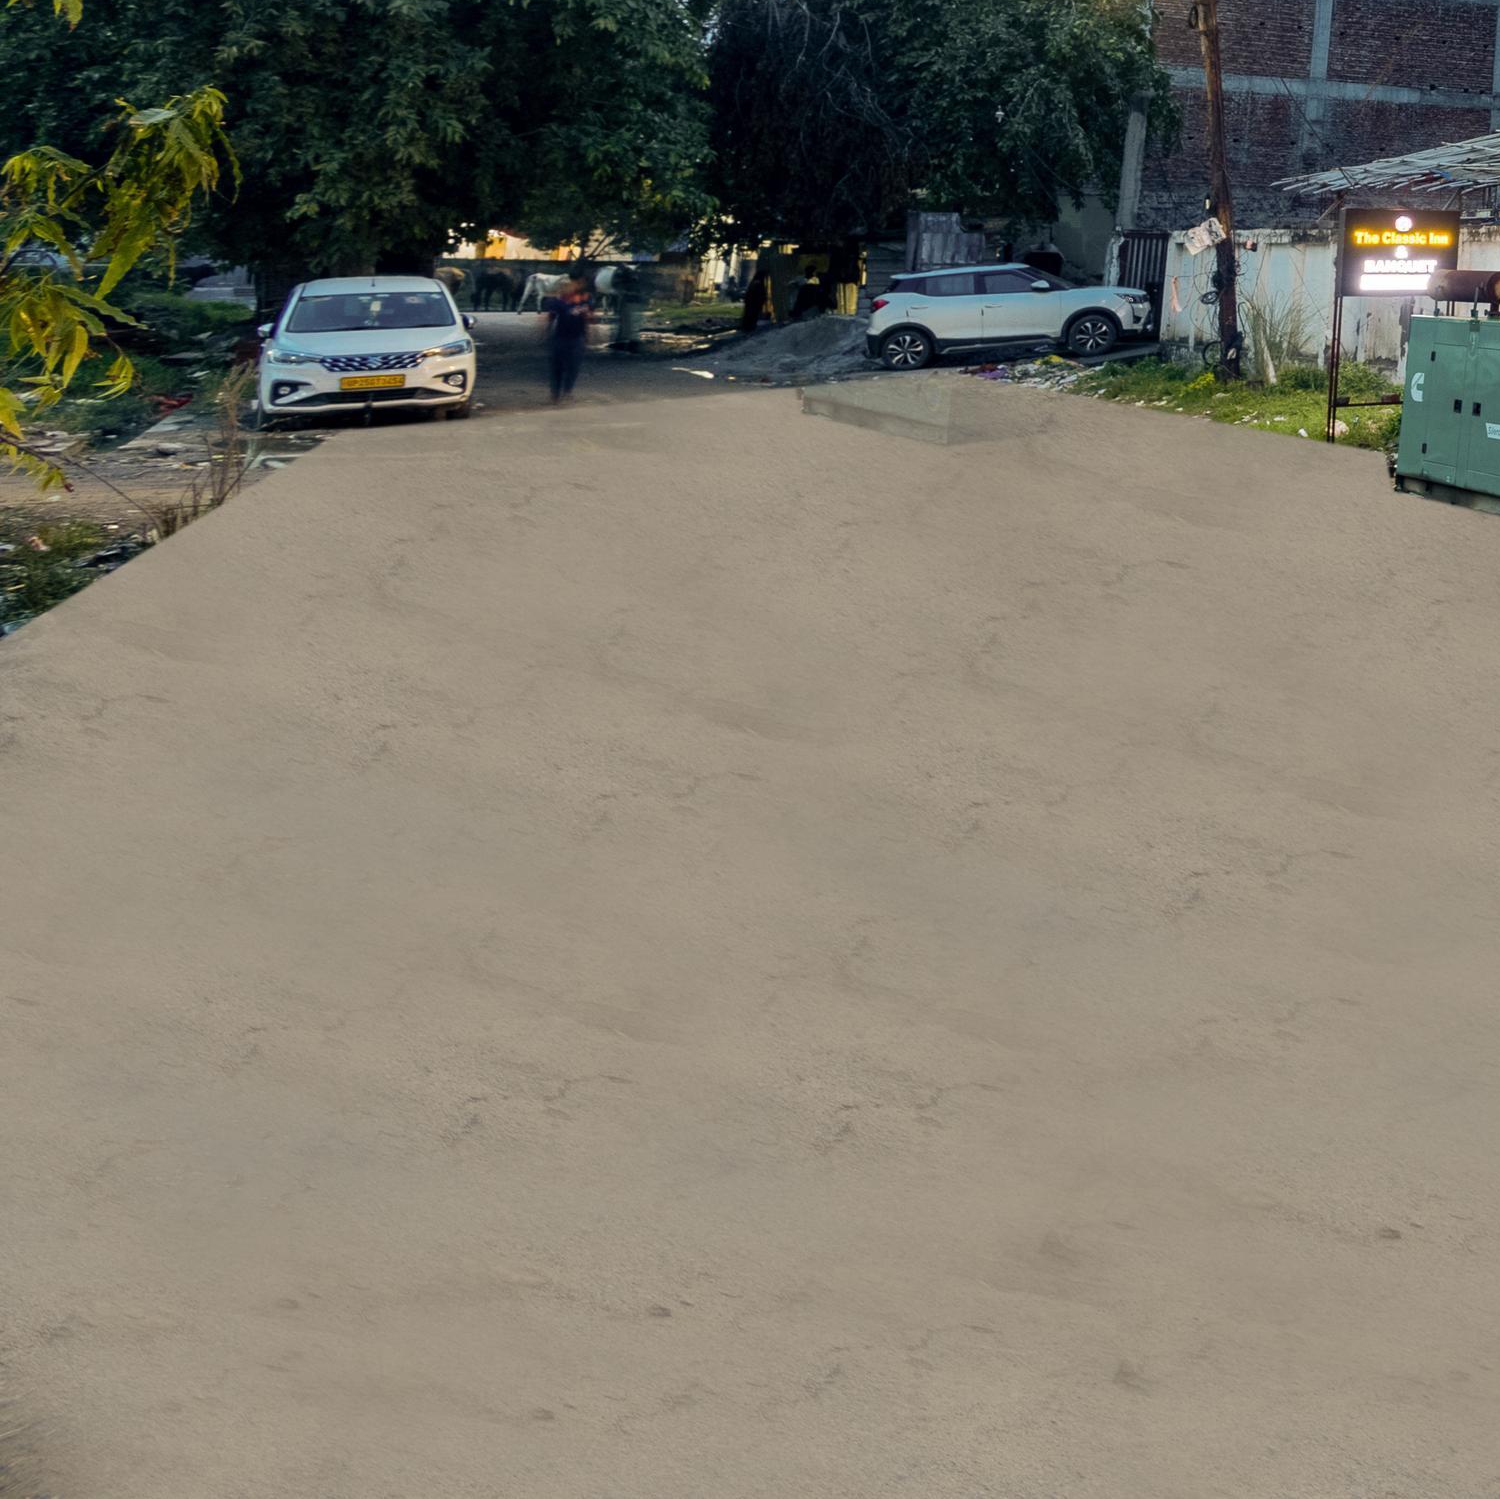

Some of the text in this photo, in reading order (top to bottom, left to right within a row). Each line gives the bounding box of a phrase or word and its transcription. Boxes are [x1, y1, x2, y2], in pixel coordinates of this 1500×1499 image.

[1354, 231, 1449, 244] The Classic Inn
[1363, 259, 1438, 273] BANQUET
